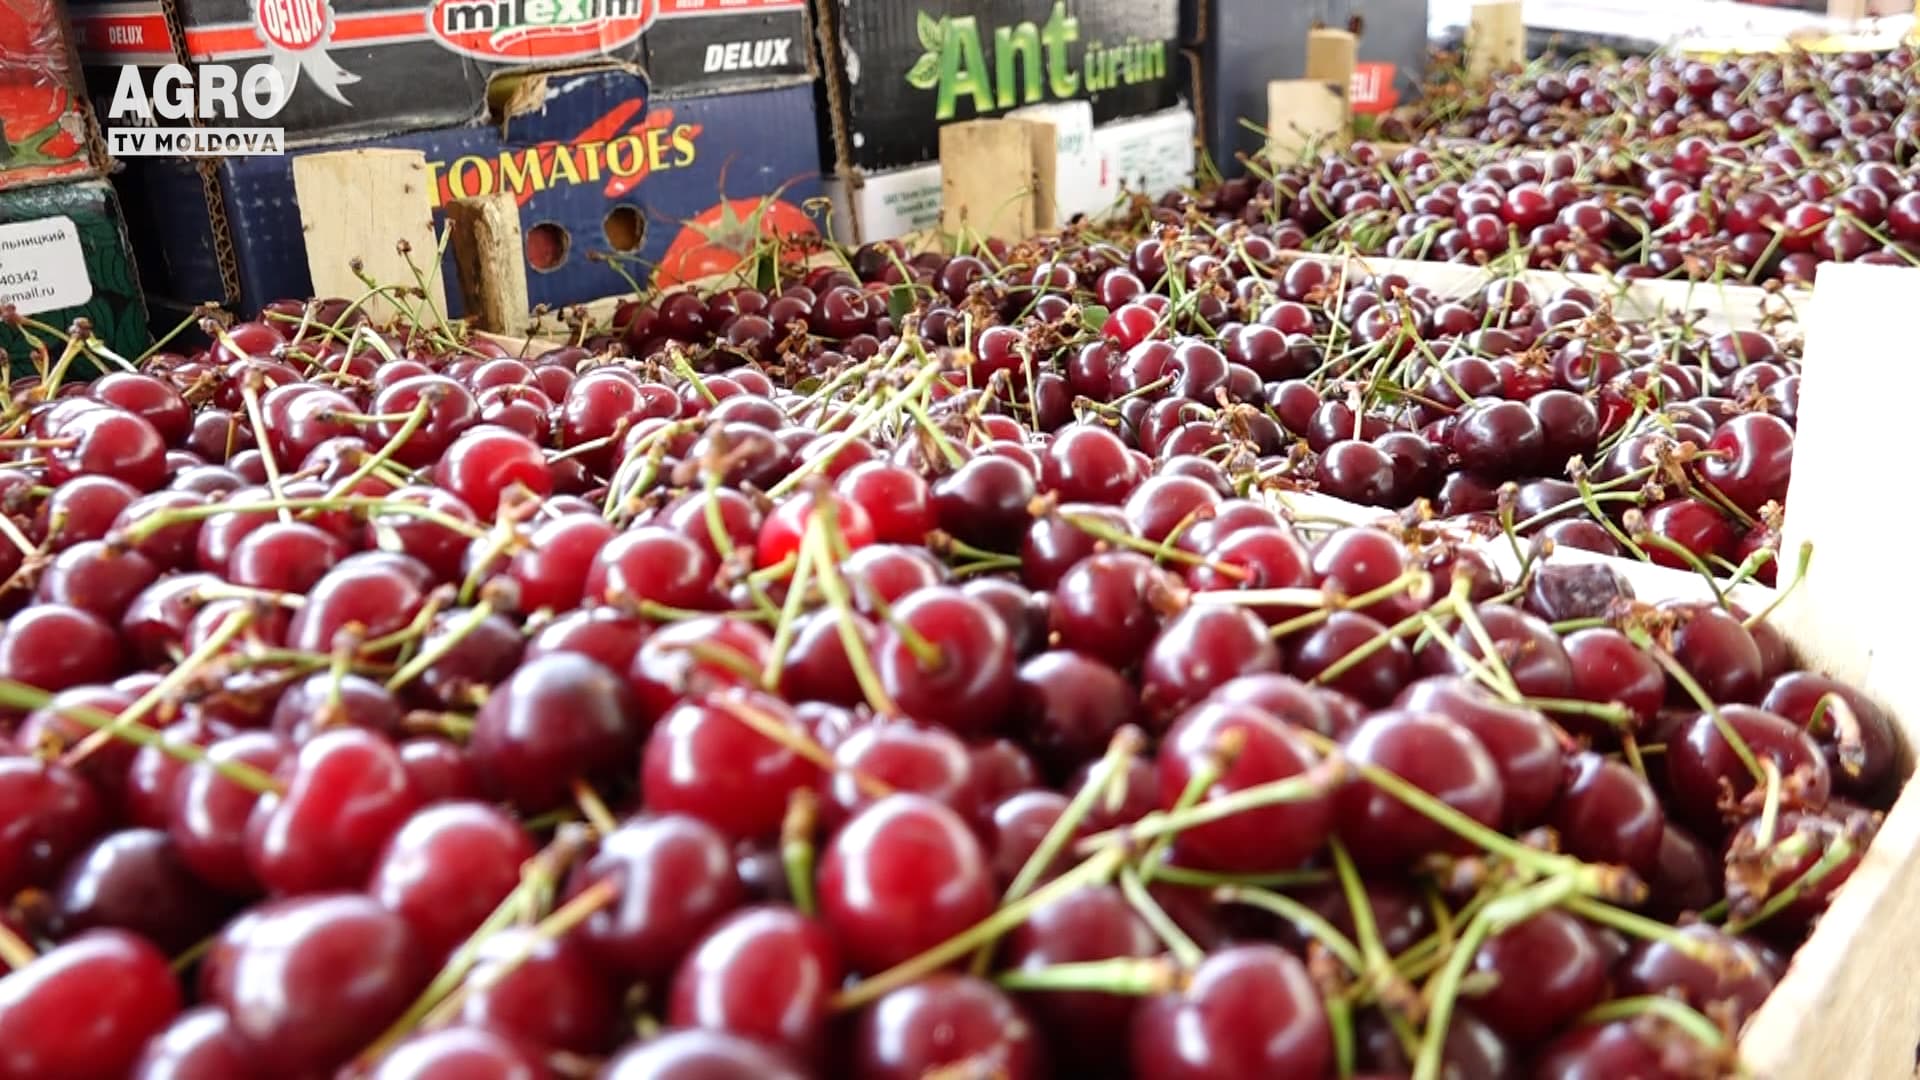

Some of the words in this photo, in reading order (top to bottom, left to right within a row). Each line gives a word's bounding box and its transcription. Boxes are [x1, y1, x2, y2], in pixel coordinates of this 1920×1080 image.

[108, 24, 144, 45] DELUX
[703, 37, 791, 73] DELUX
[936, 1, 1079, 120] Ant
[1084, 35, 1166, 92] ürün
[425, 123, 696, 208] TOMATOES
